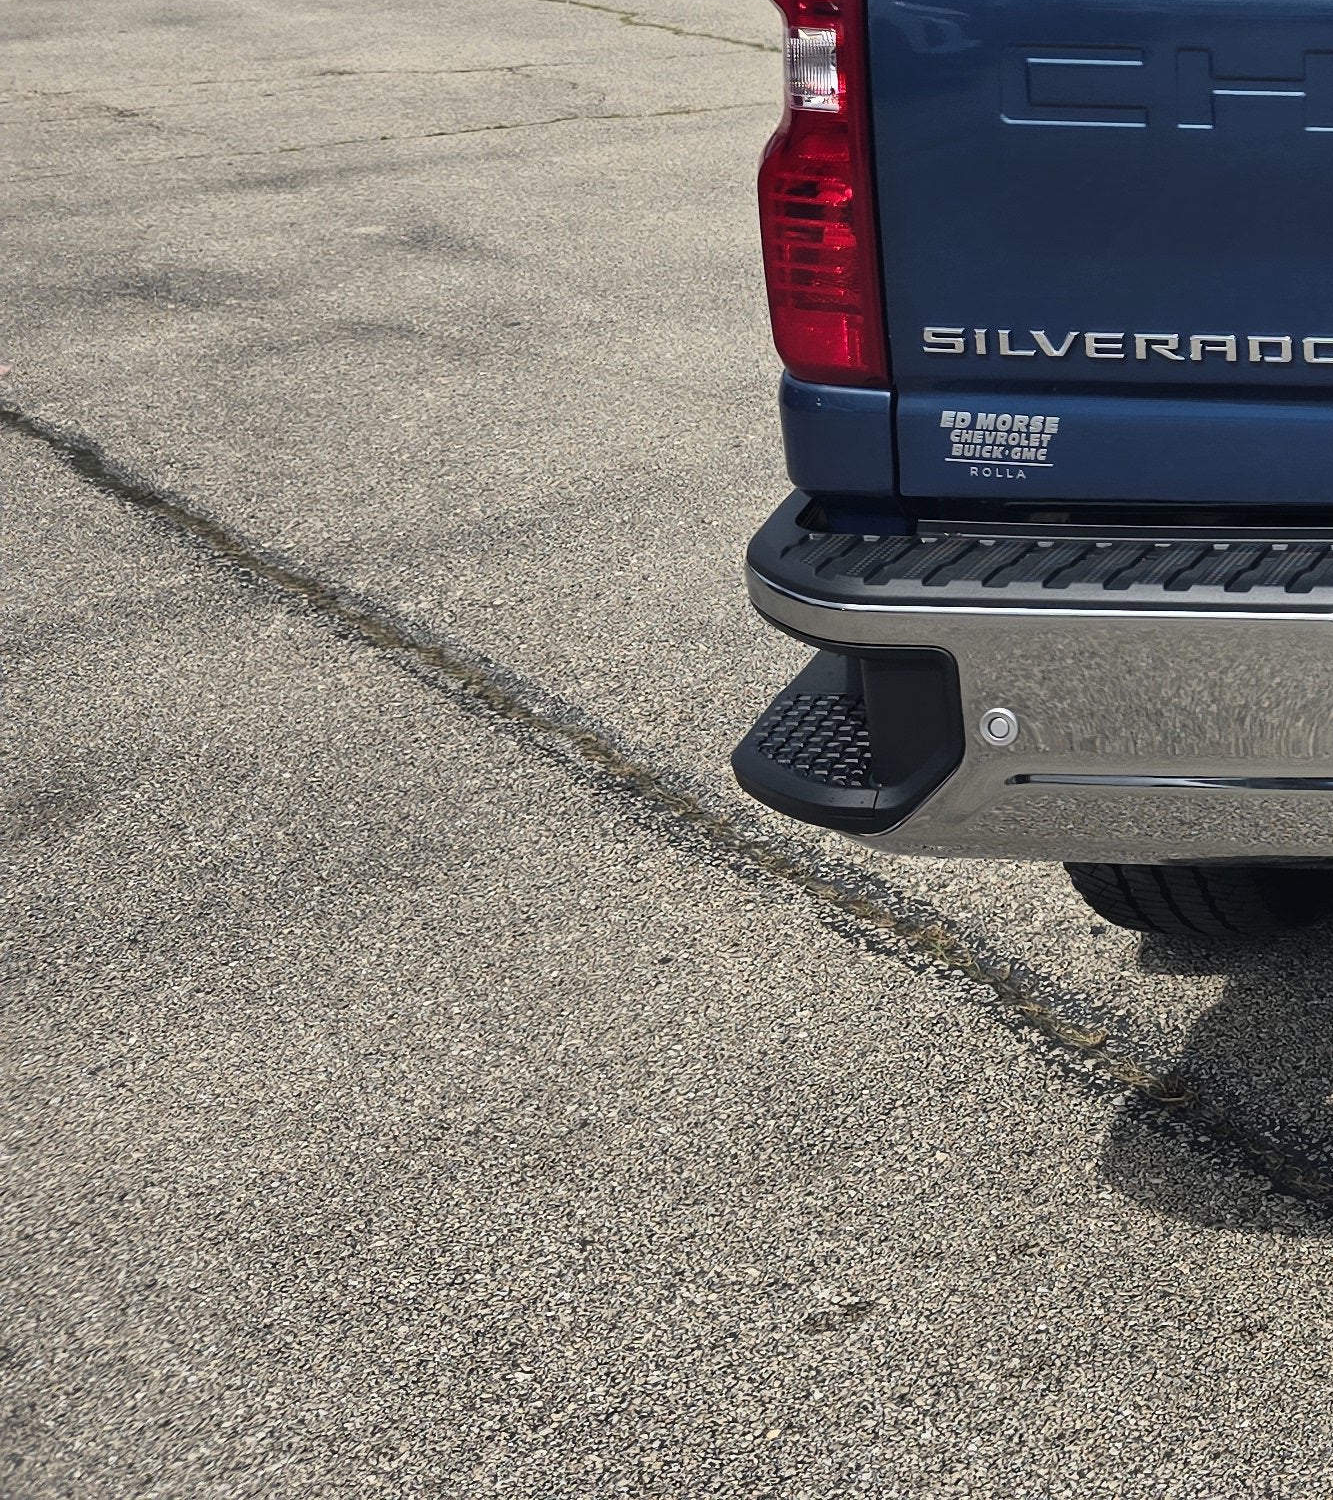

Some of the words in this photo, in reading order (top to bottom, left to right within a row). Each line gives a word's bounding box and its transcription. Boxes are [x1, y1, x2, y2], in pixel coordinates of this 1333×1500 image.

[940, 410, 972, 429] ED
[975, 412, 1060, 434] MORSE
[950, 429, 1052, 447] CHEVROLET
[969, 466, 1027, 479] ROLLA
